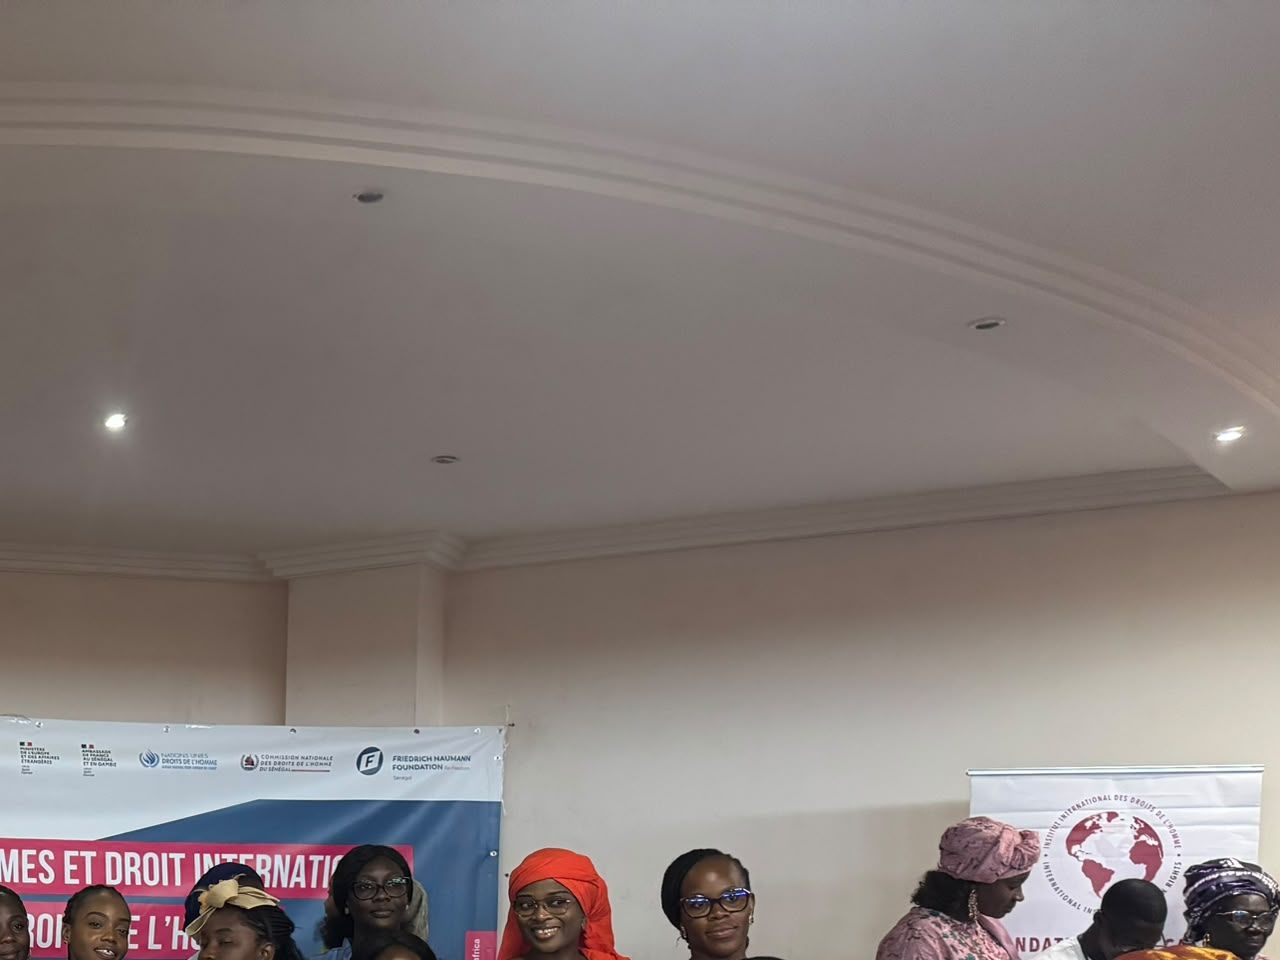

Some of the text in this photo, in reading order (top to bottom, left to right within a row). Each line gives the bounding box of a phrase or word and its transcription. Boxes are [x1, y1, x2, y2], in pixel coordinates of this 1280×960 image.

[365, 754, 376, 768] F
[1043, 794, 1182, 849] INSTITUT INTERNATIONAL DES DROITS DE L'HOMME
[64, 850, 97, 885] ET
[105, 851, 185, 887] DROIT
[1043, 861, 1081, 910] INTERNATIONAL
[1165, 861, 1182, 888] RIGHTS
